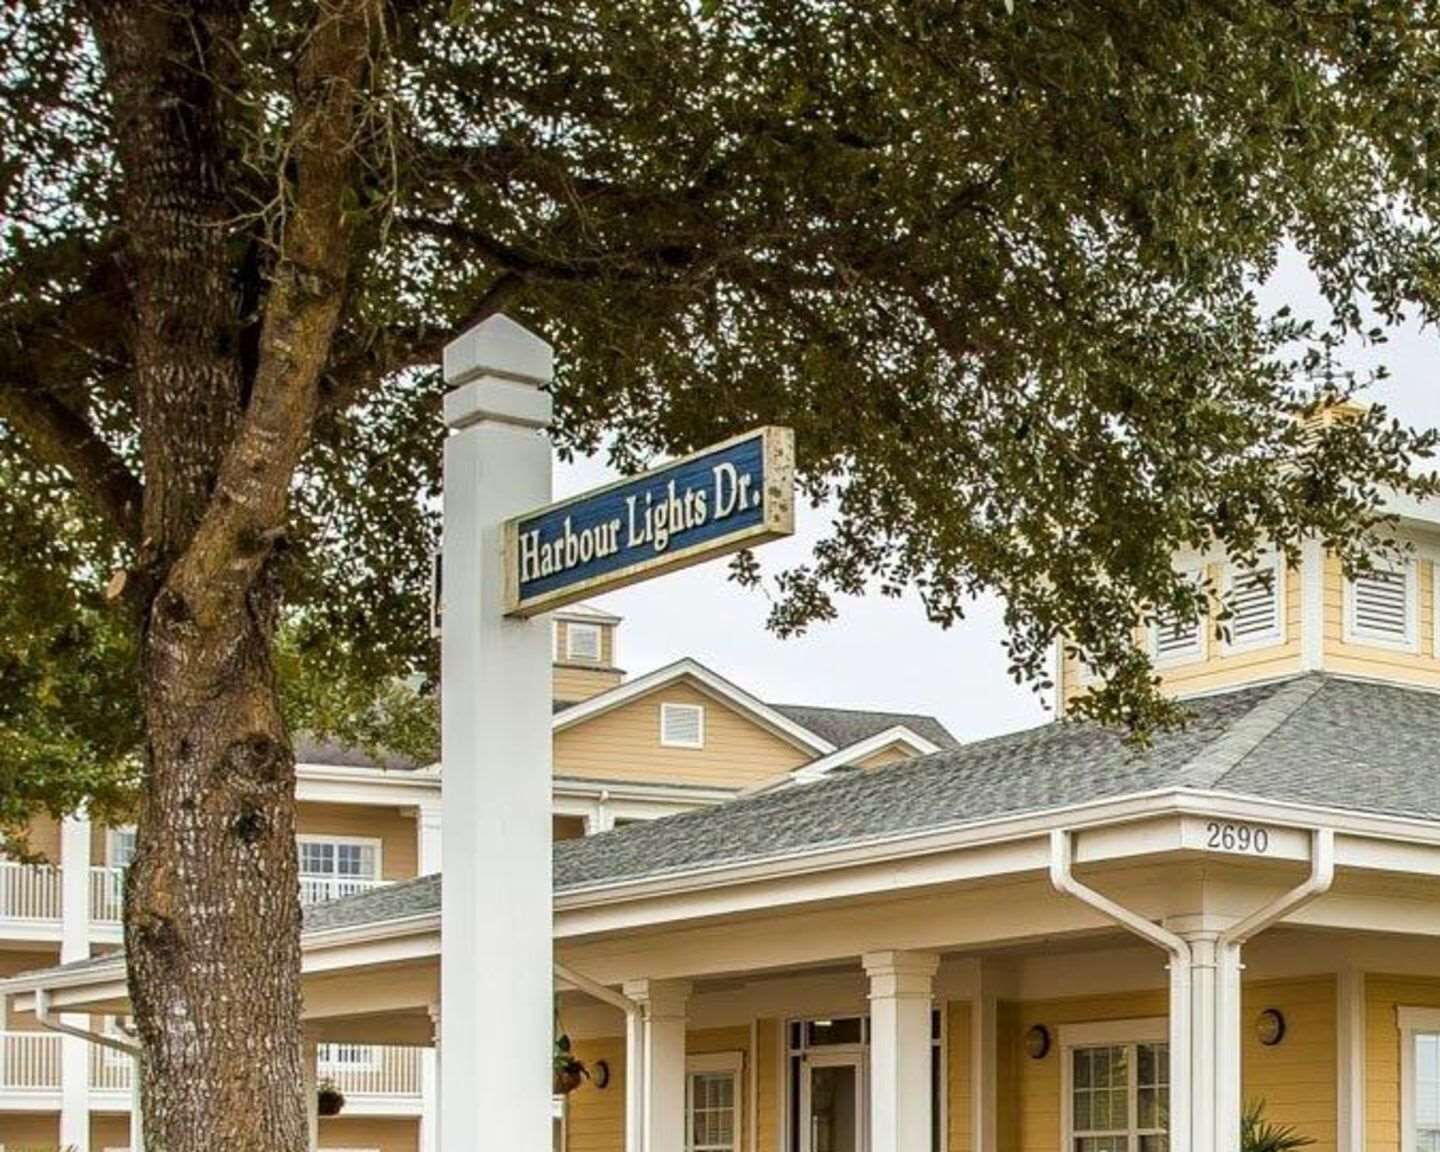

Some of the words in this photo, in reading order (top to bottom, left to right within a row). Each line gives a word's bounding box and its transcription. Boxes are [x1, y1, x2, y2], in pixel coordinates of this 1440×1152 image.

[519, 515, 621, 584] Harbour
[626, 479, 707, 551] Lights
[714, 461, 761, 520] Dr.
[1206, 822, 1269, 853] 2690
